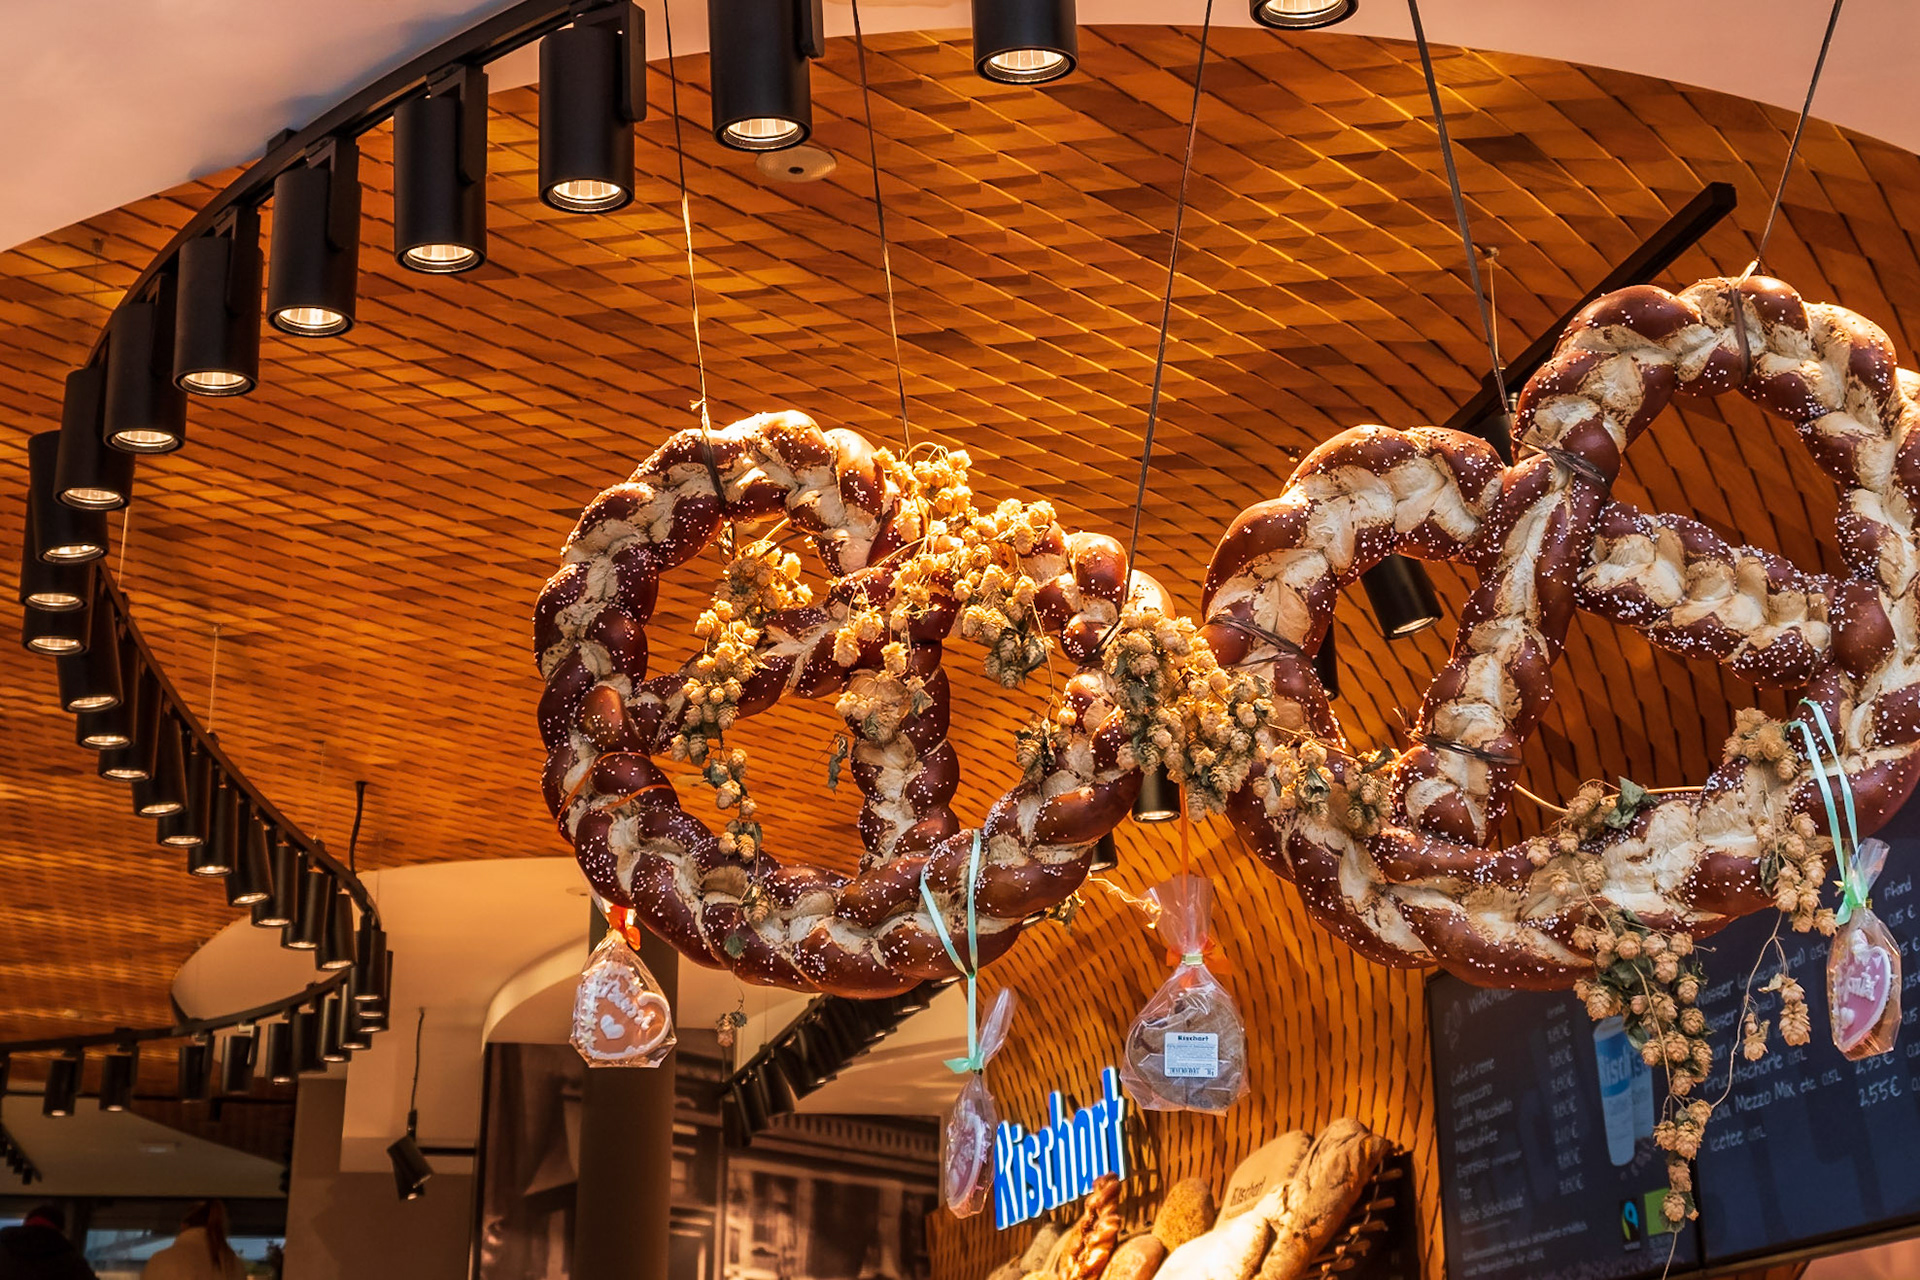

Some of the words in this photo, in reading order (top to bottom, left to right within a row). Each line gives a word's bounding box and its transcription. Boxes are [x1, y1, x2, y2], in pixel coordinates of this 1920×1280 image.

[1734, 1090, 1771, 1113] Mezzo
[1774, 1080, 1796, 1100] Mix
[994, 1066, 1126, 1231] Rischart
